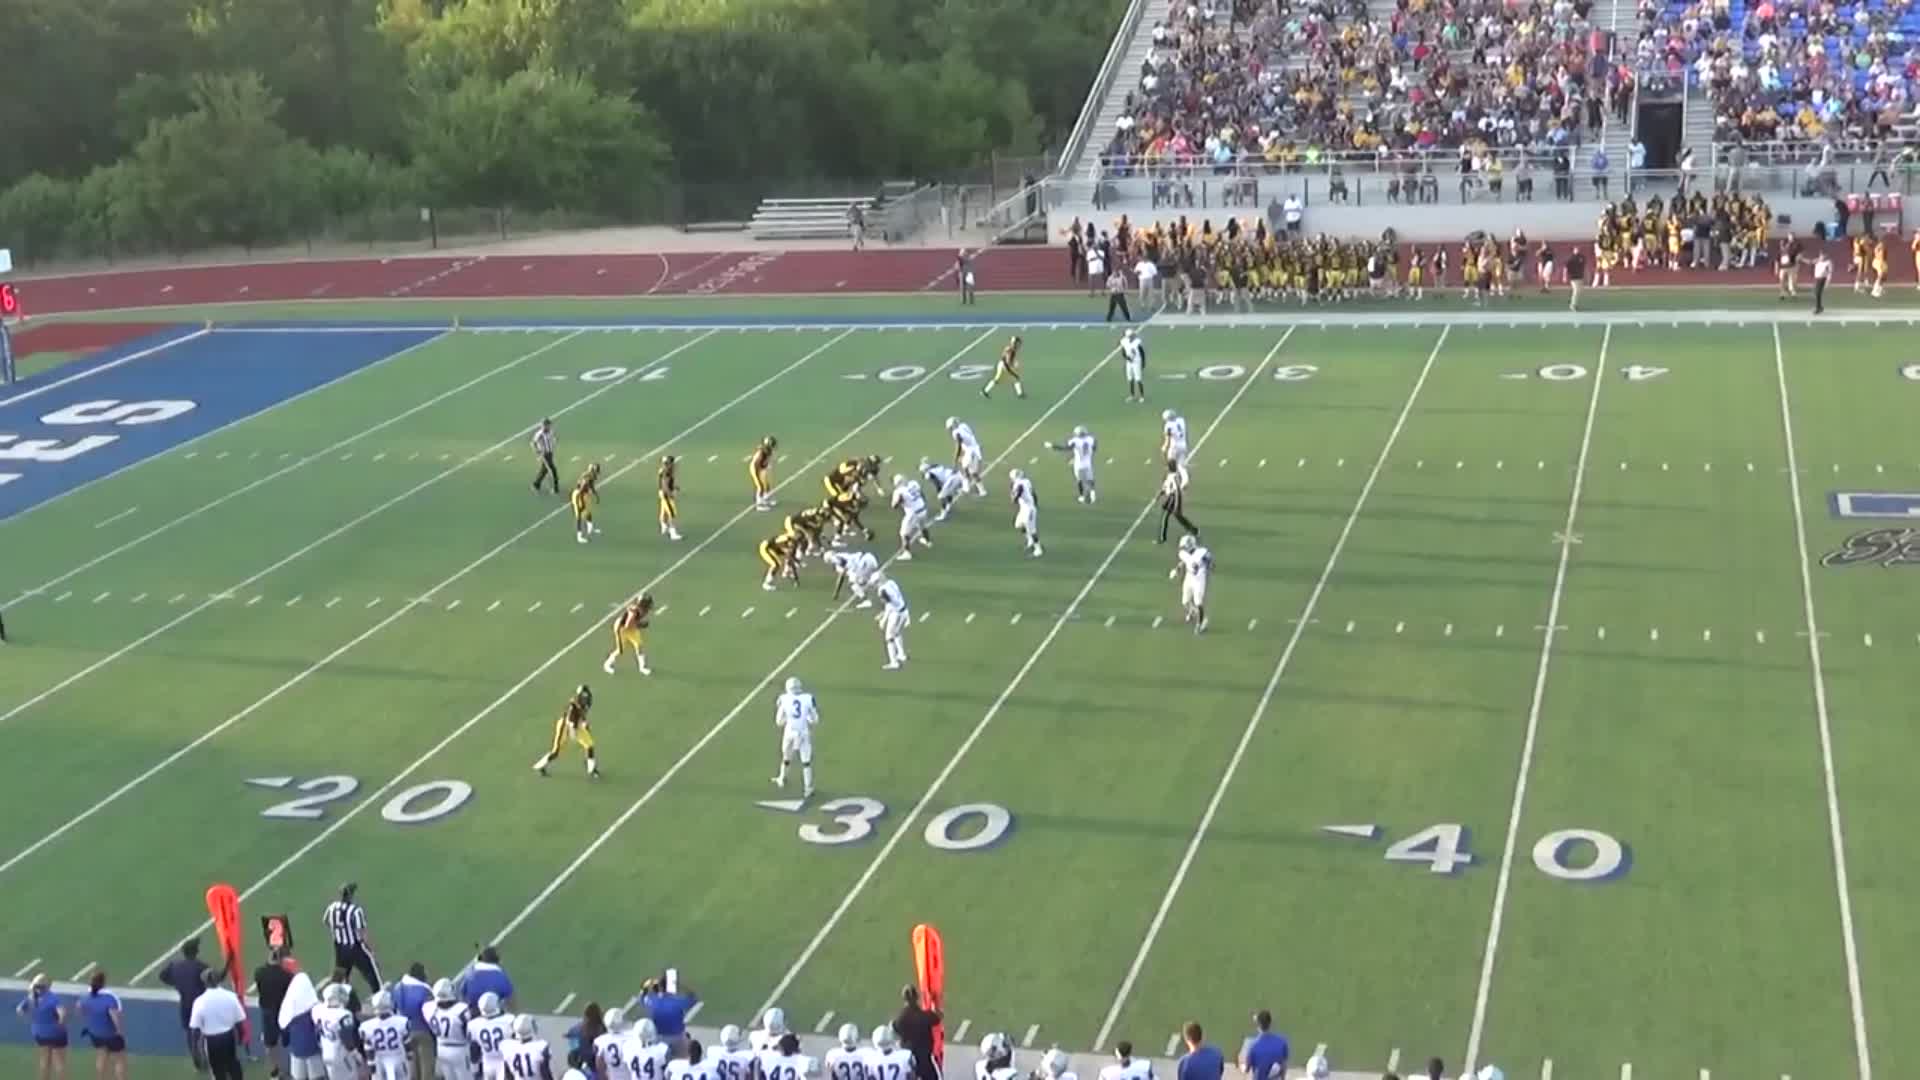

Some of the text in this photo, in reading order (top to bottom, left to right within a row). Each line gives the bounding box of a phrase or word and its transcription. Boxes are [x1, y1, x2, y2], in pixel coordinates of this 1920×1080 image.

[793, 701, 802, 718] 3
[267, 918, 284, 947] 2
[374, 1026, 399, 1050] 22
[480, 1027, 504, 1053] 92
[512, 1053, 534, 1077] 41
[631, 1055, 655, 1079] 44
